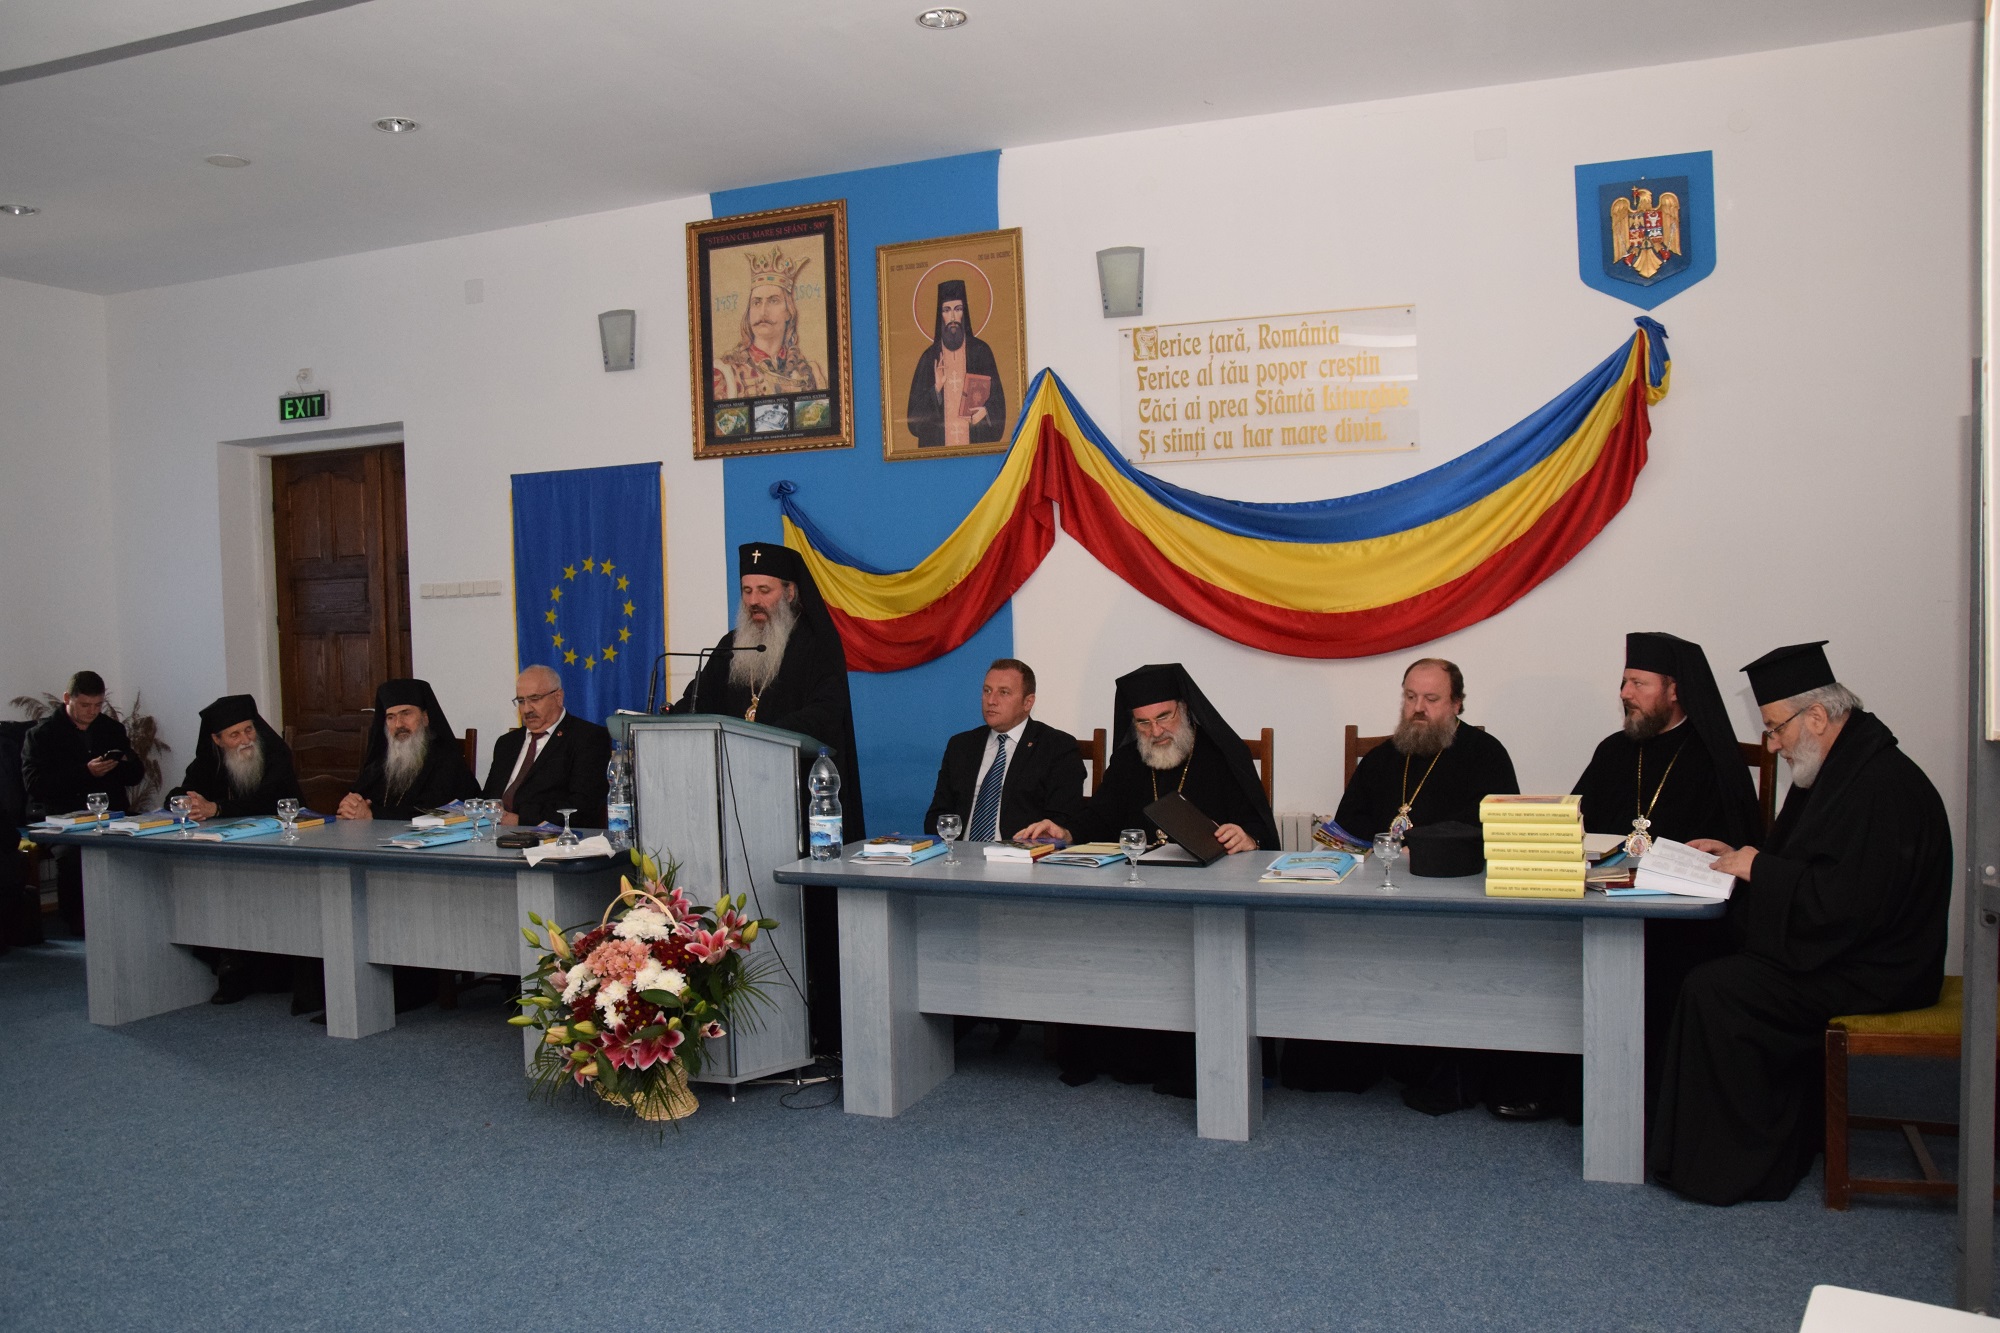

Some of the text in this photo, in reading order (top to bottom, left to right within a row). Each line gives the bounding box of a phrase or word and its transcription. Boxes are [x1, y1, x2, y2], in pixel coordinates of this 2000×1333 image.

[737, 231, 751, 241] CEL
[752, 229, 775, 239] MARE
[1258, 320, 1340, 350] România
[1136, 351, 1381, 391] Ferice al tău popor creștin
[285, 397, 320, 419] EXIT
[1138, 397, 1177, 424] Căci
[1184, 396, 1201, 421] ai
[1209, 396, 1248, 425] prea
[1255, 387, 1315, 416] Sfântă
[1213, 430, 1233, 450] cu
[1243, 423, 1273, 448] har
[1281, 423, 1328, 446] mare
[1335, 416, 1388, 444] divin.
